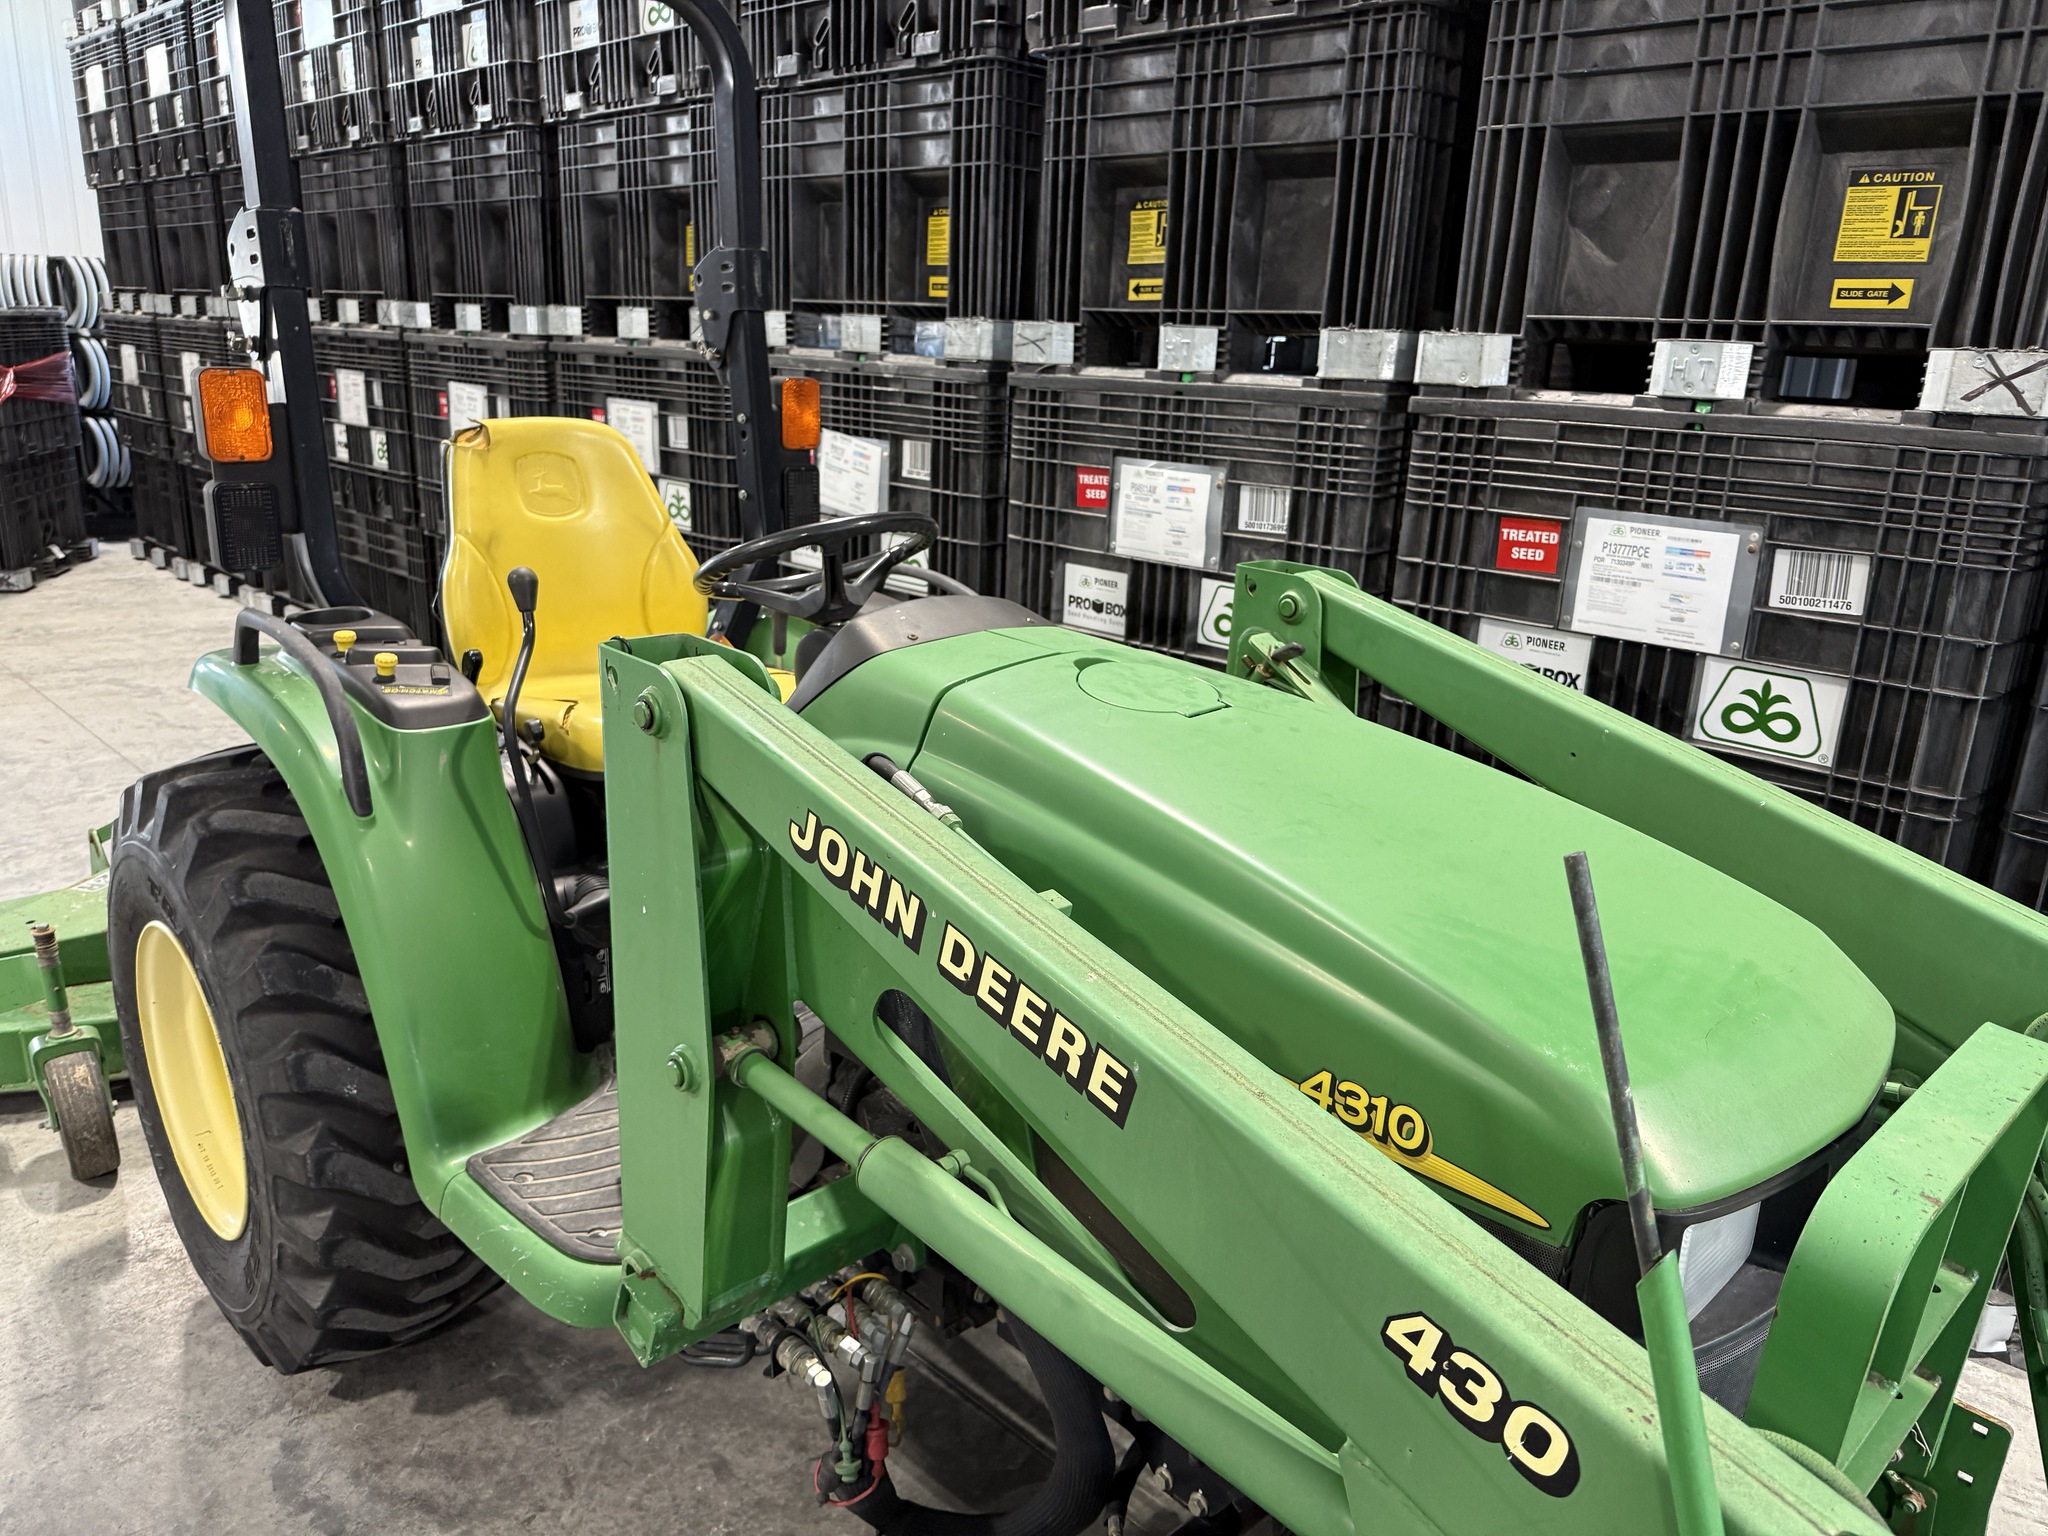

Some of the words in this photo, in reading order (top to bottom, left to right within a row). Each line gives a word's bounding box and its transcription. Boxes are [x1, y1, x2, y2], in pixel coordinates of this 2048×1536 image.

[1873, 172, 1935, 183] CAUTION
[1143, 201, 1169, 209] CAUTIO
[1079, 474, 1109, 485] TREATE
[1085, 489, 1107, 499] SEED
[1502, 528, 1559, 544] TREATED
[1629, 526, 1661, 537] PIONEER
[1511, 547, 1544, 561] SEED
[1601, 541, 1650, 559] P13777PCE
[1094, 577, 1118, 589] PIONEER
[1068, 595, 1091, 610] PRO
[1105, 602, 1126, 618] BOX
[1779, 595, 1852, 611] 500100211476
[1526, 635, 1565, 652] PIONEER
[789, 809, 925, 948] JOHN
[938, 921, 1133, 1122] DEERE
[1299, 1069, 1429, 1156] 4310
[1382, 1312, 1577, 1490] 430
